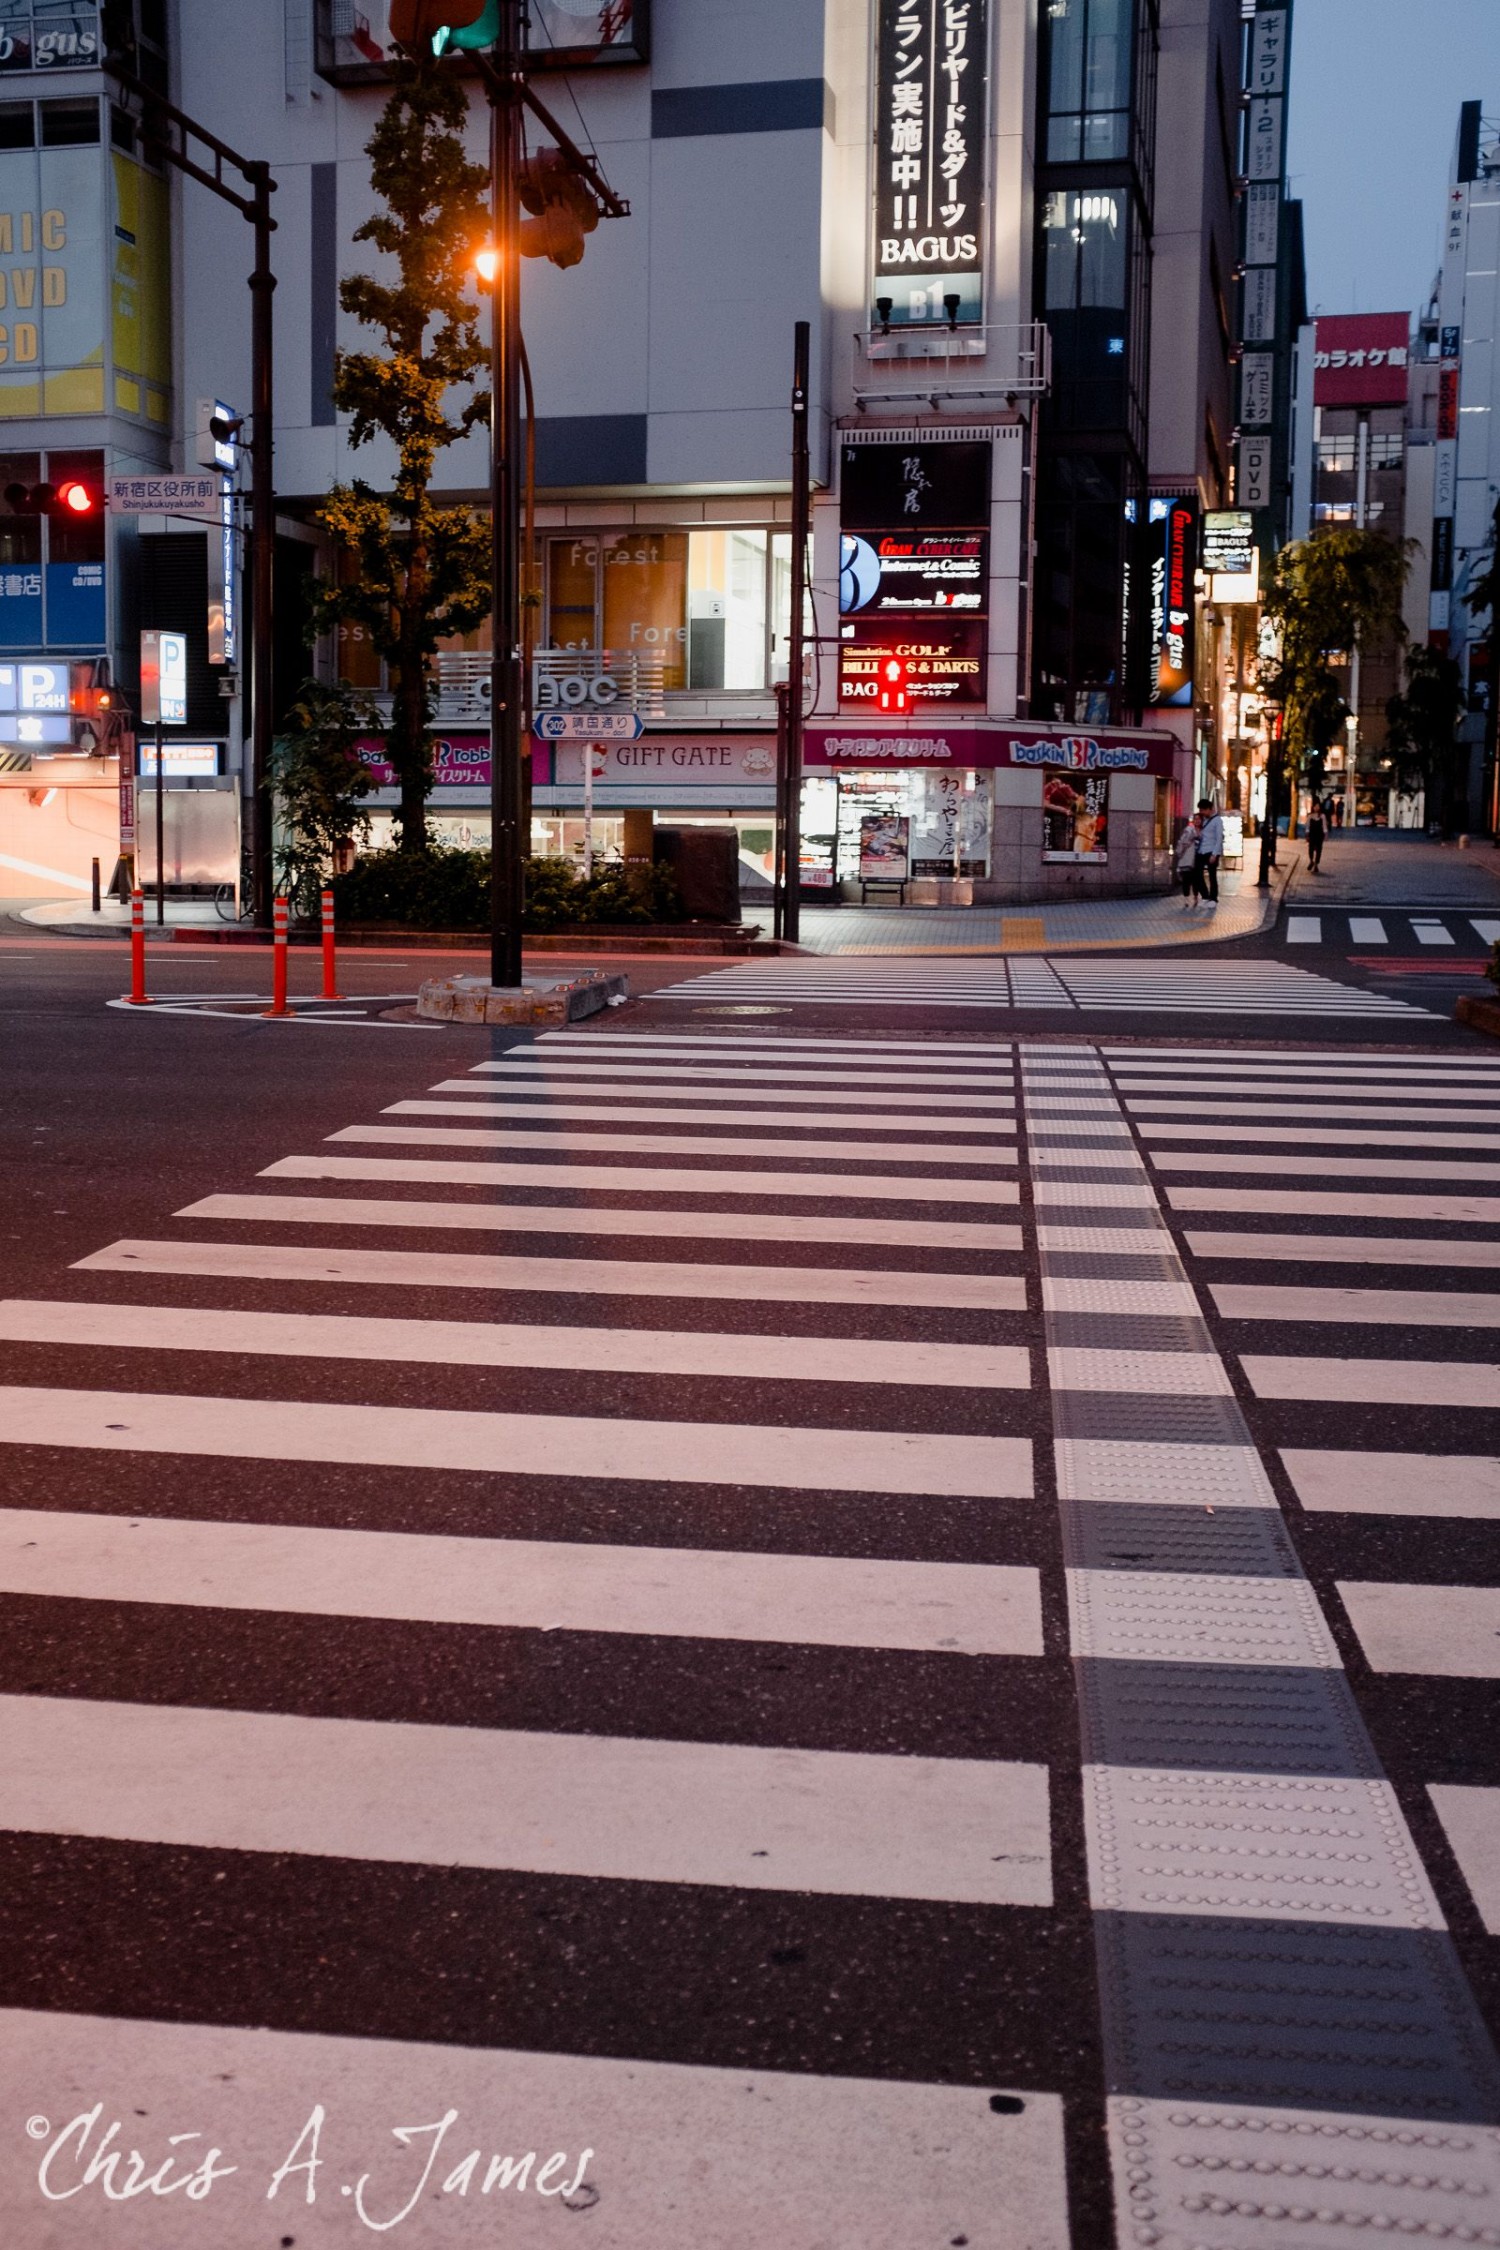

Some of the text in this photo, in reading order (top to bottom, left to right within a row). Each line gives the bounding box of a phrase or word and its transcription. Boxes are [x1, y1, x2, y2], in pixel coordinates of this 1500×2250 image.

[939, 0, 972, 228] ビリヤード&ダーツ
[880, 234, 978, 263] BAGUS
[909, 281, 944, 319] B1
[1314, 346, 1408, 369] カラオケ館
[1257, 371, 1270, 419] コミック
[1248, 454, 1262, 501] DVD
[114, 481, 214, 498] 新宿区役所前
[122, 499, 205, 511] Shinjukukuyakusho
[1217, 537, 1249, 547] BAGUS
[570, 545, 658, 567] Forest
[165, 641, 180, 673] P
[895, 645, 953, 656] GOLF
[842, 661, 917, 674] BILLIS
[933, 661, 980, 674] DARTS
[21, 667, 56, 708] P
[842, 682, 879, 697] BAG
[35, 694, 66, 708] 24H
[549, 716, 628, 731] 302 靖国通り
[616, 746, 732, 766] GIFT GATE
[1009, 740, 1066, 765] baskin
[1099, 747, 1150, 770] robbins
